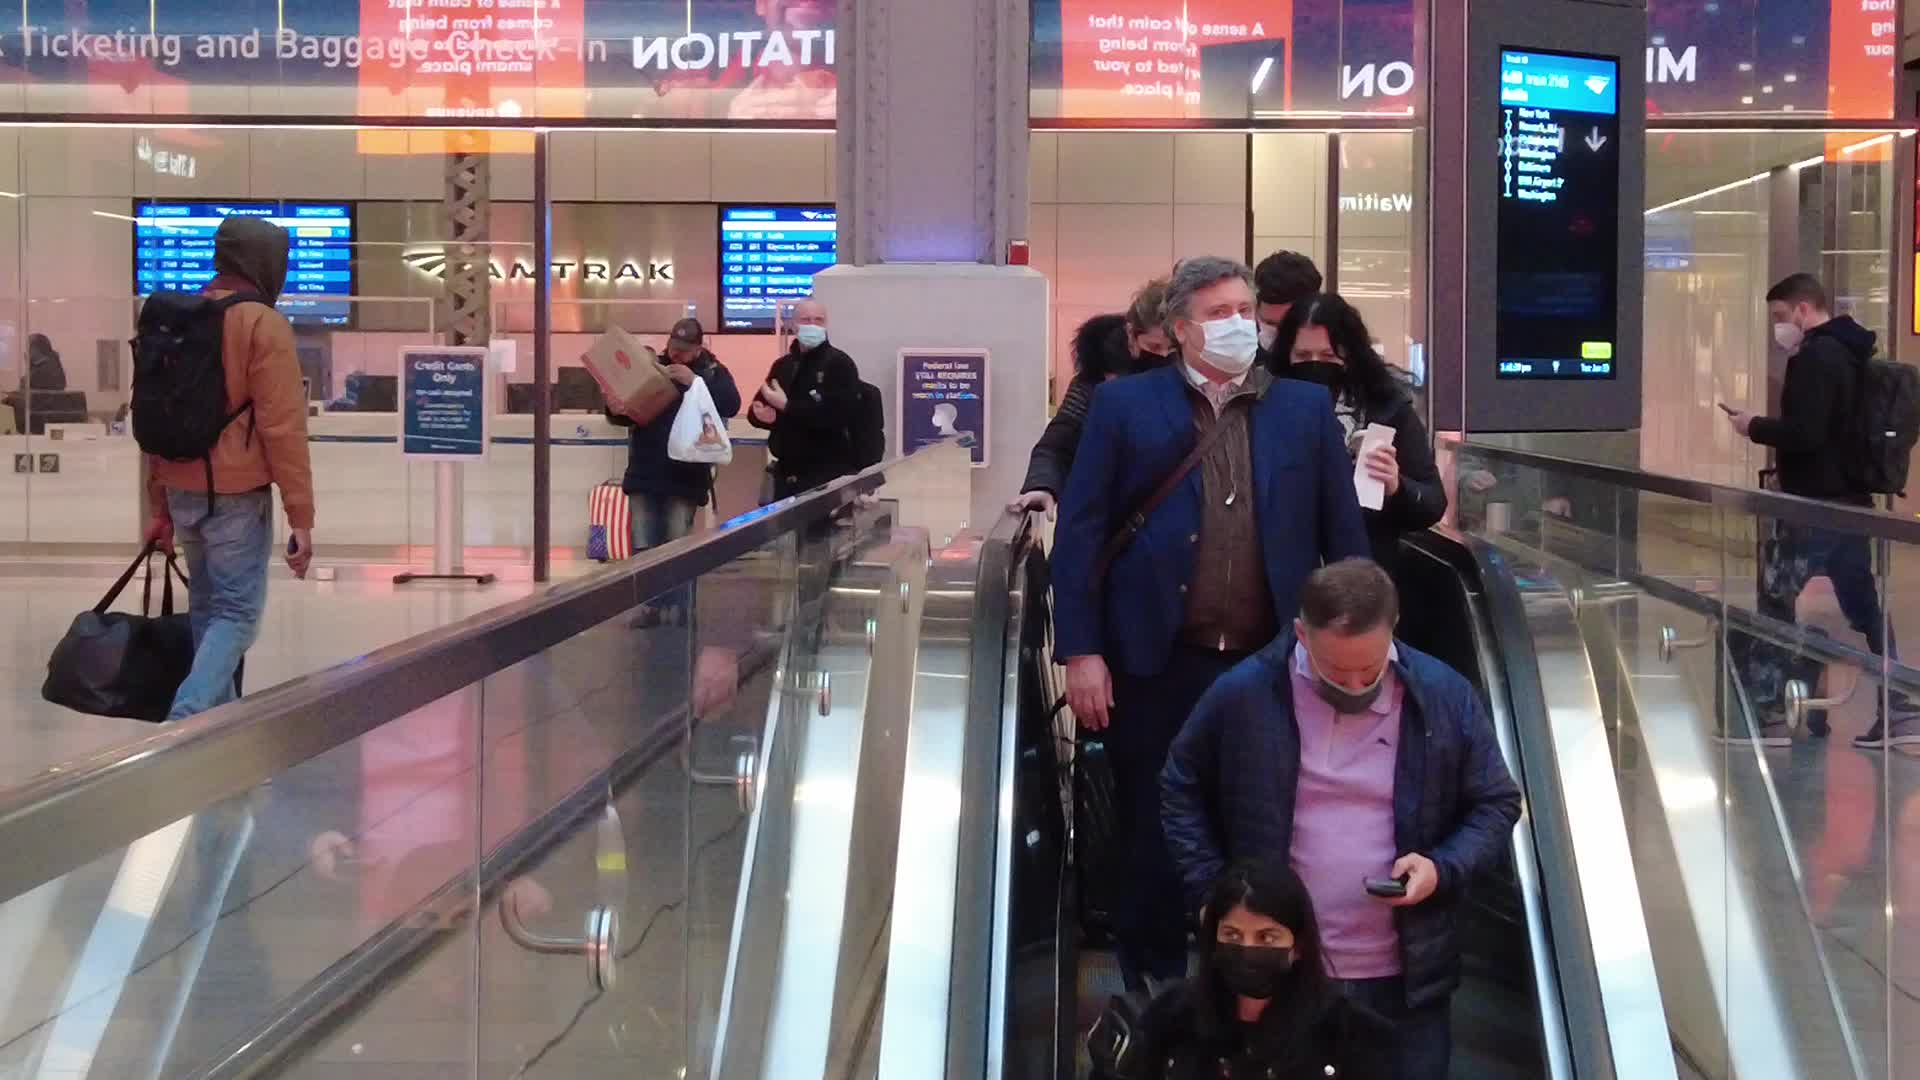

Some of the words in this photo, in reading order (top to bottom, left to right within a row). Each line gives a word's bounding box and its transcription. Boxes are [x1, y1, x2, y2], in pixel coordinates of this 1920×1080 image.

[17, 26, 181, 65] Ticketing
[196, 28, 260, 59] and
[275, 28, 429, 68] Baggage
